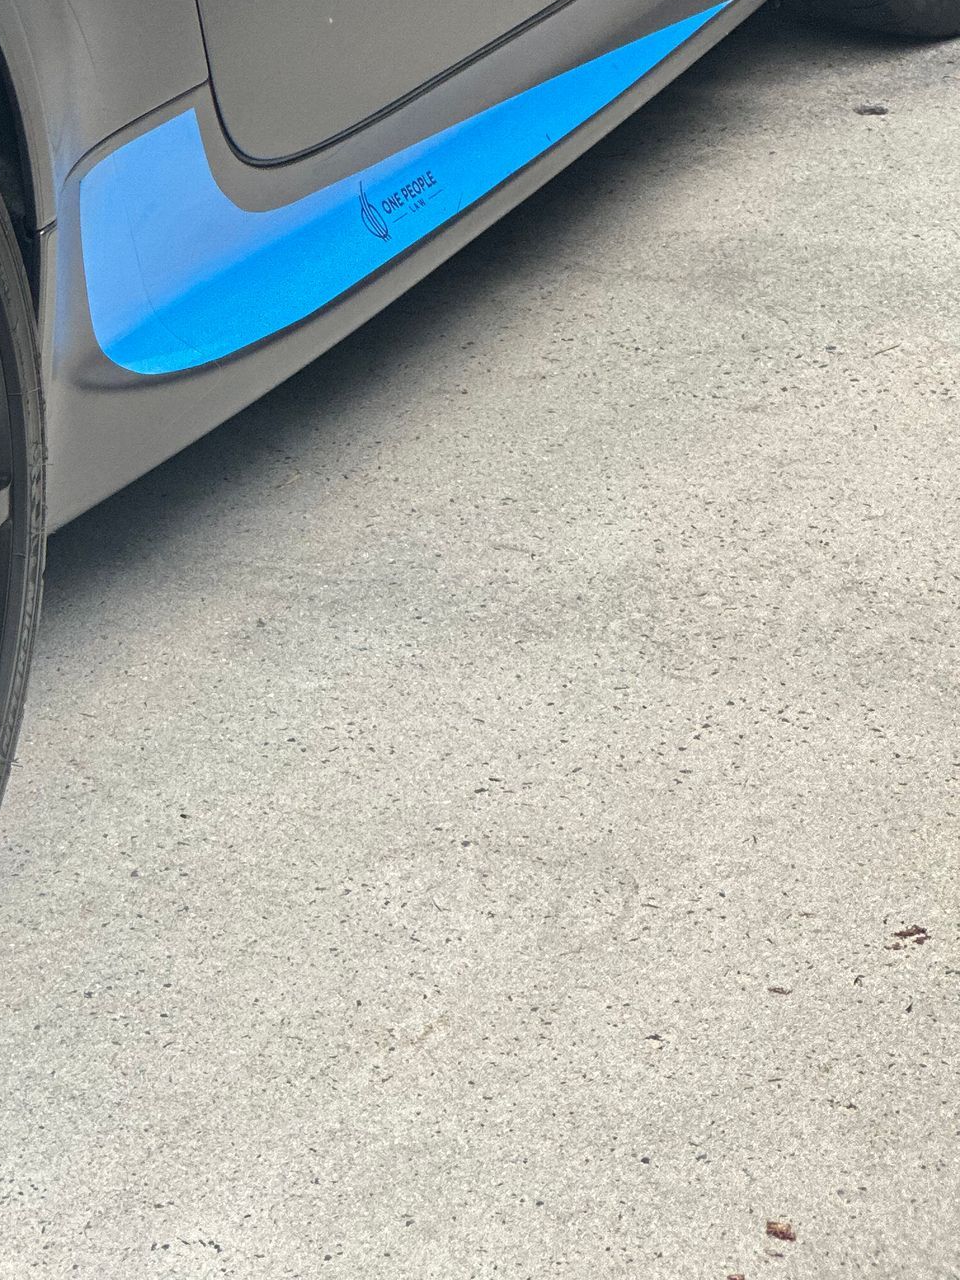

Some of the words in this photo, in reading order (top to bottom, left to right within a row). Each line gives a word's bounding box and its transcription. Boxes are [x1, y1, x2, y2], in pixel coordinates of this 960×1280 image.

[382, 192, 404, 214] ONE
[400, 170, 437, 201] PEOPLE
[408, 198, 426, 213] LAW
